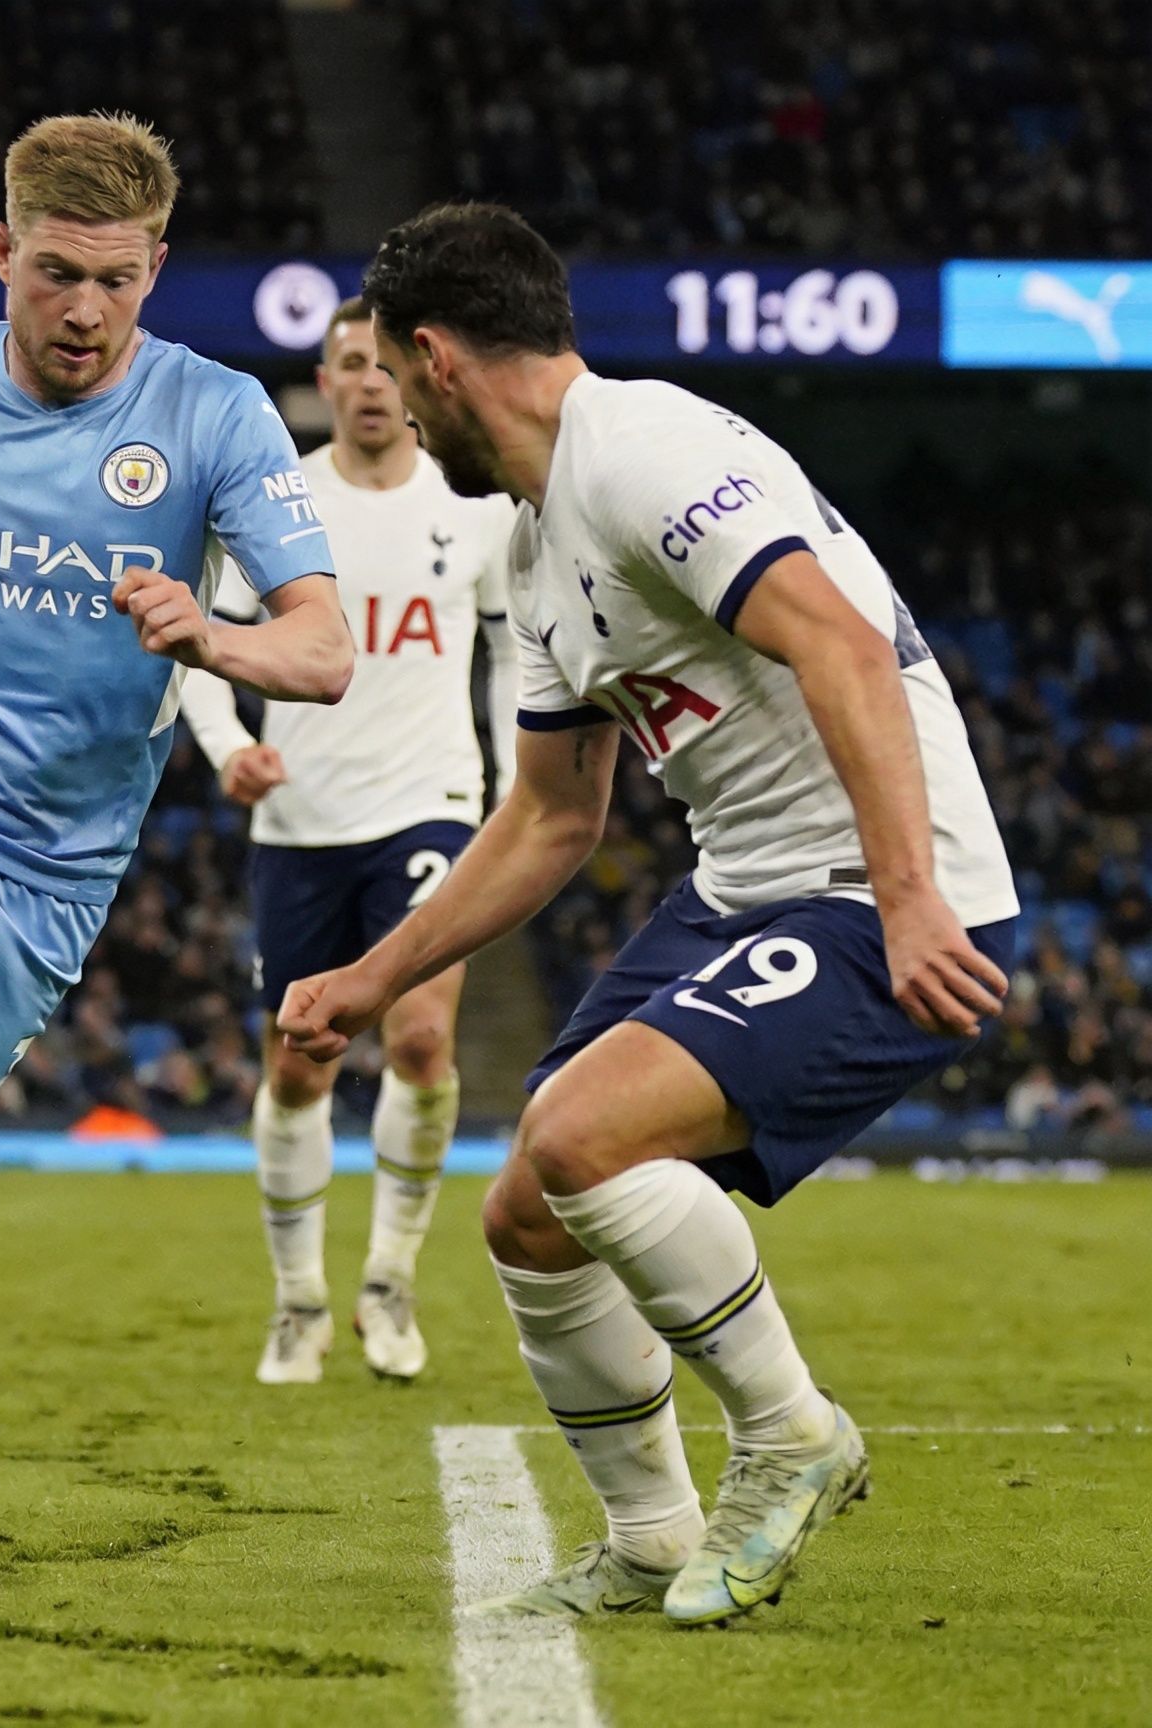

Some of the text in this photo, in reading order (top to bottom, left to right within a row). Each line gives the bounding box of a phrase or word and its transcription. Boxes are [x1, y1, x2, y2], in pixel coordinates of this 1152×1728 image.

[664, 268, 899, 355] 11:60
[261, 470, 309, 501] NE
[661, 474, 765, 563] cinch
[365, 595, 442, 656] IA
[581, 672, 722, 762] IA
[406, 849, 450, 909] 2
[691, 934, 818, 1008] 19
